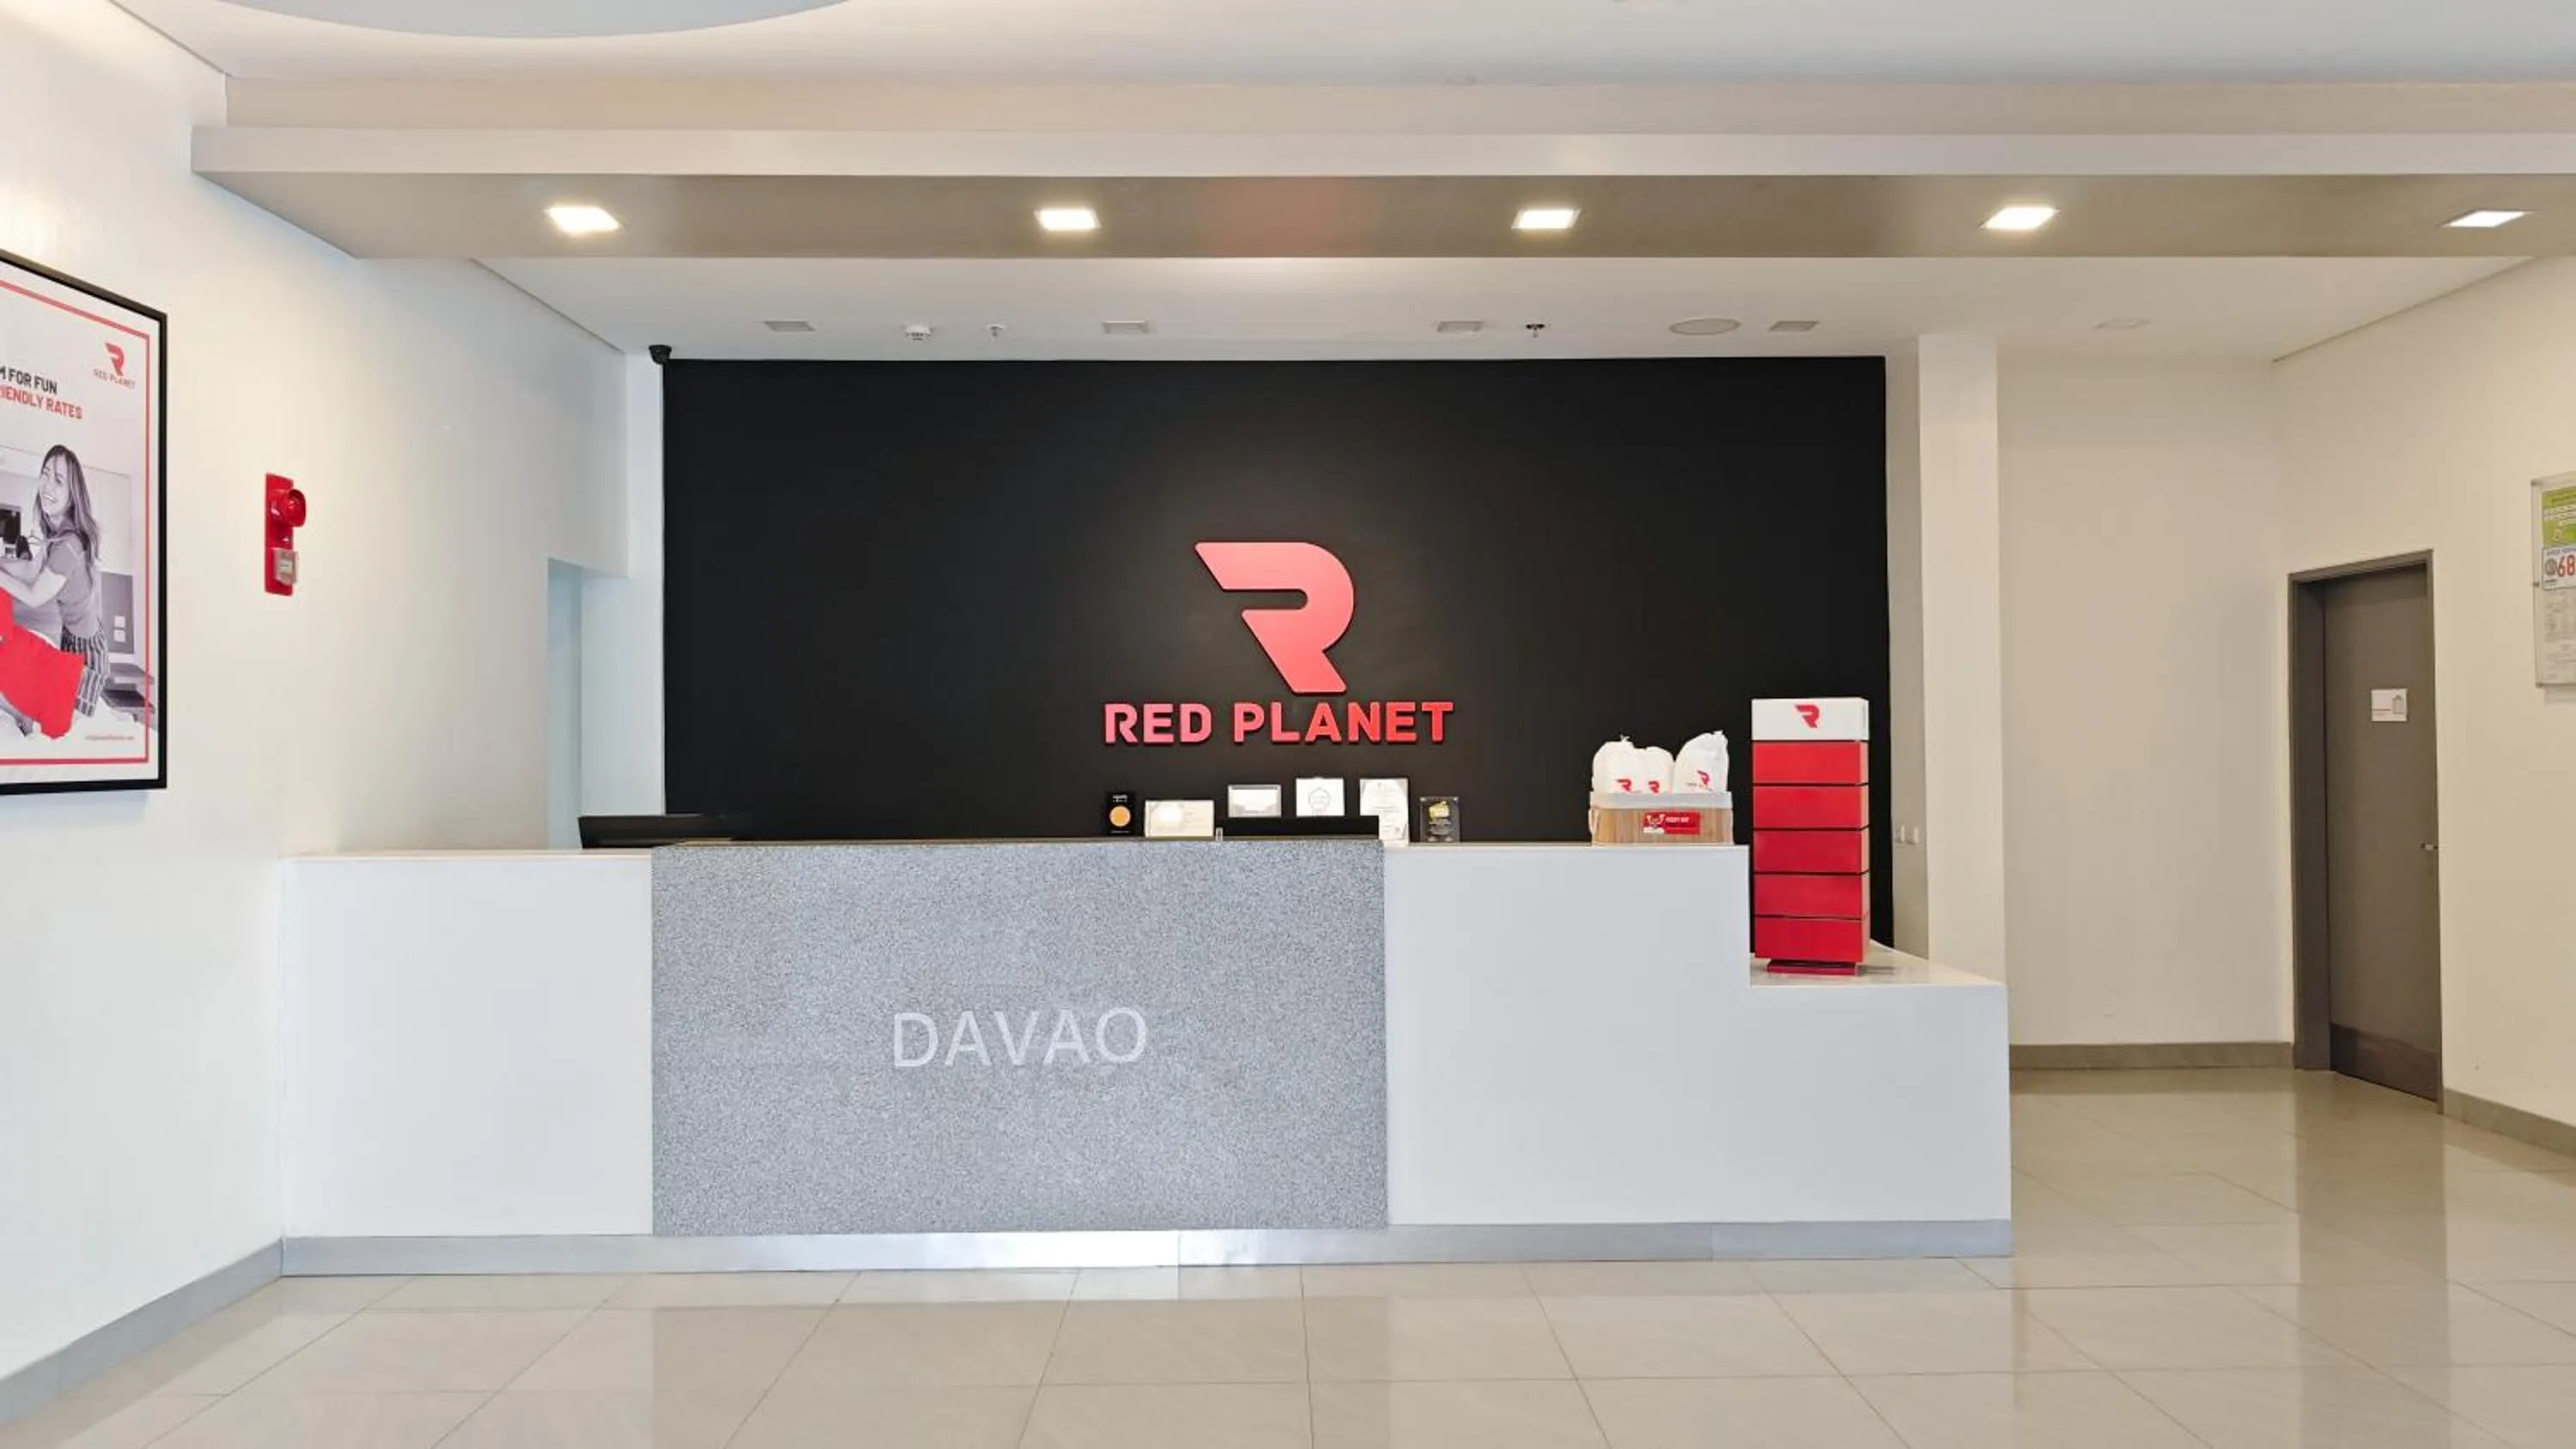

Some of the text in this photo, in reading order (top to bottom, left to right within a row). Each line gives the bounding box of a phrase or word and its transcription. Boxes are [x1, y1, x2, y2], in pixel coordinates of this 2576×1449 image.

[8, 368, 32, 389] FOR
[33, 376, 58, 395] FUN
[46, 397, 83, 420] RATES
[1194, 542, 1355, 695] R
[1104, 701, 1454, 747] RED PLANET
[894, 1007, 1147, 1067] DAVAO
